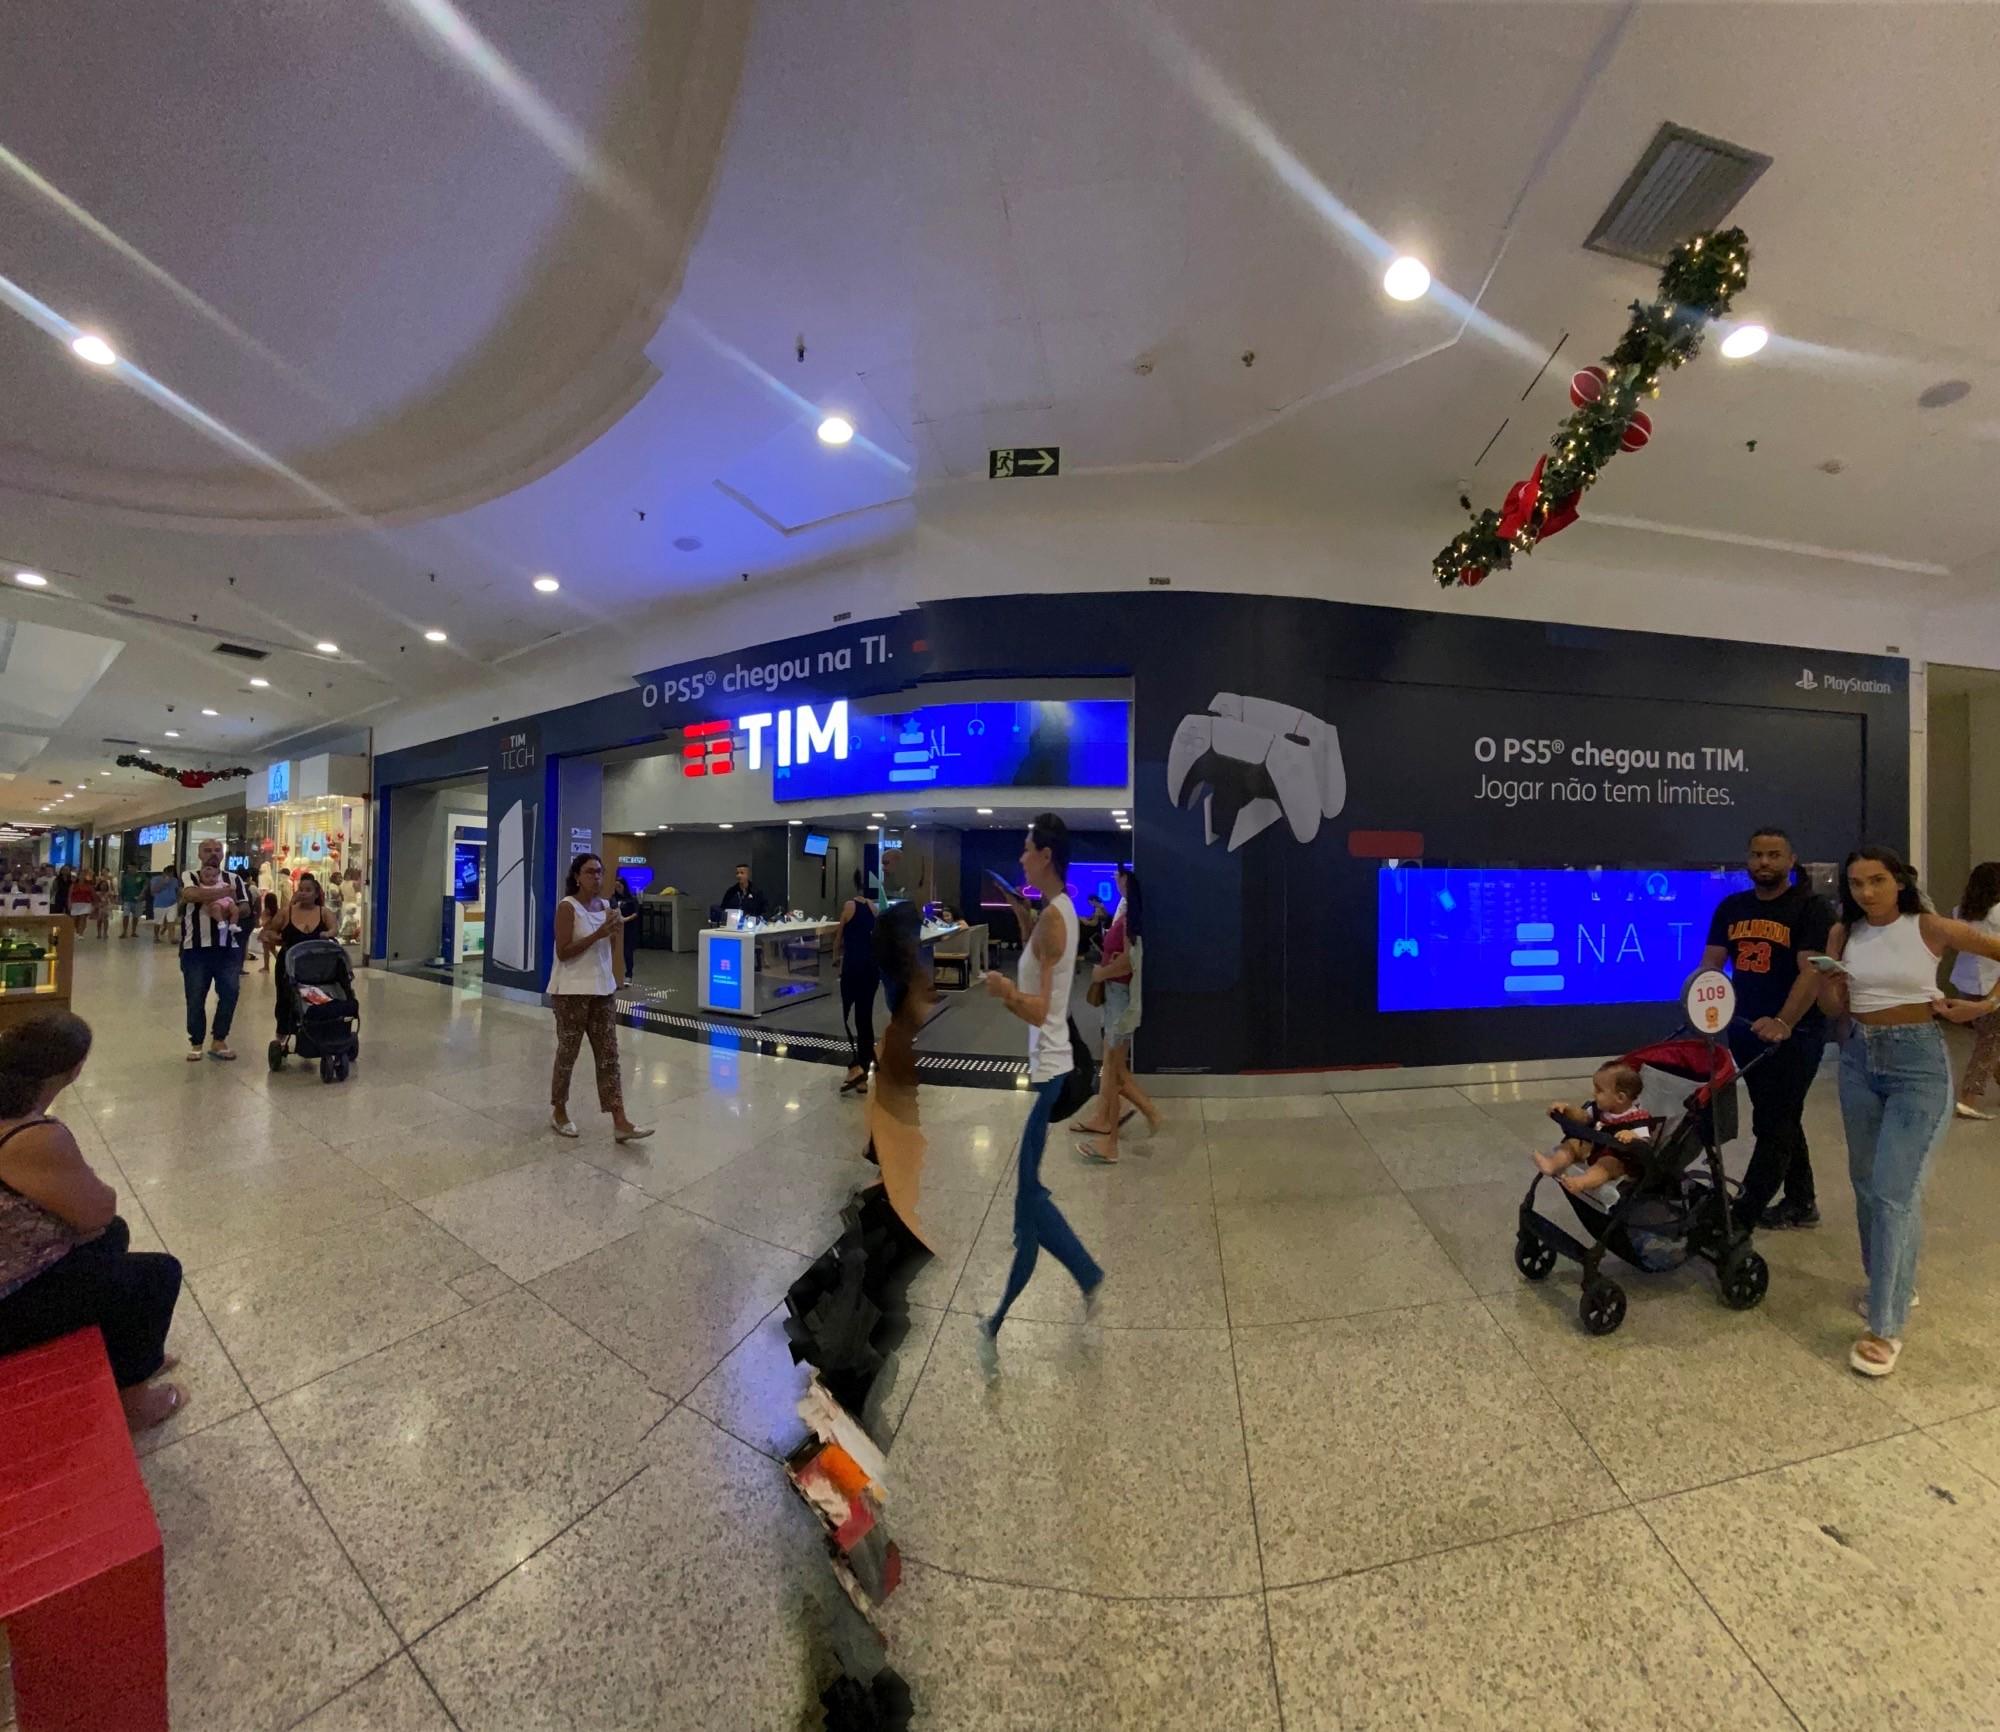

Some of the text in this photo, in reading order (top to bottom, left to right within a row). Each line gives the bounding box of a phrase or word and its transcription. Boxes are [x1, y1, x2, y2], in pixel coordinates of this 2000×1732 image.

[642, 684, 659, 708] O
[722, 656, 810, 692] chegou
[818, 648, 852, 674] na
[1823, 675, 1891, 694] PlayStation
[510, 732, 526, 749] TIM
[738, 698, 849, 770] TIM
[501, 745, 535, 770] TECH
[1474, 736, 1497, 763] O
[1571, 741, 1660, 775] chegou
[1667, 753, 1696, 770] na
[1701, 747, 1749, 773] TIM.
[1474, 774, 1736, 808] Jogar não tem limites.
[1736, 940, 1772, 974] 23
[1696, 985, 1726, 1003] 109
